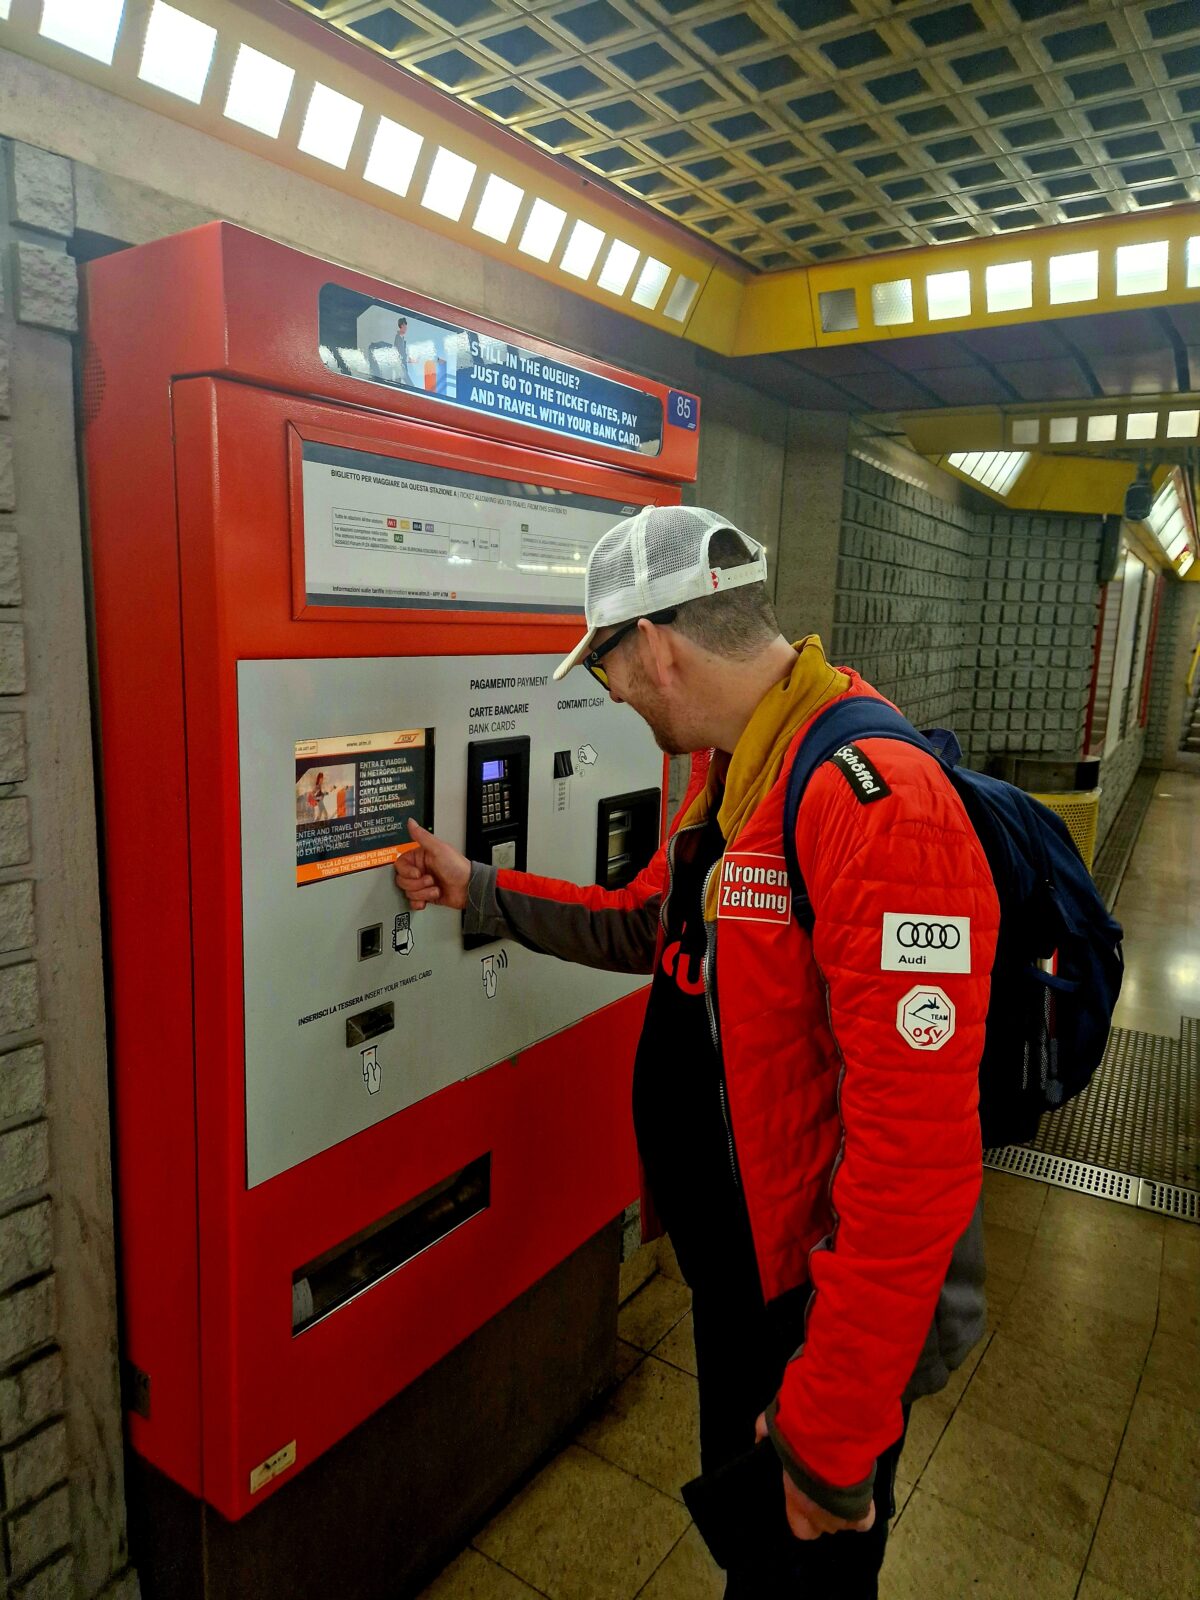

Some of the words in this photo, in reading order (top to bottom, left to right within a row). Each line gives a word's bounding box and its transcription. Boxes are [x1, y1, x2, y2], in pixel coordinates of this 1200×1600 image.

[471, 341, 503, 365] STILL
[506, 352, 518, 370] IN
[520, 358, 540, 377] THE
[542, 365, 580, 390] QUEUE?
[470, 365, 499, 386] JUST
[502, 374, 516, 391] GO
[519, 379, 532, 396] TO
[534, 383, 554, 403] THE
[556, 391, 589, 413] TICKET
[591, 404, 620, 424] GATES,
[622, 412, 637, 428] PAY
[677, 396, 691, 419] 85
[470, 387, 495, 407] AND
[497, 394, 537, 419] TRAVEL
[540, 406, 565, 427] WITH
[567, 414, 591, 433] YOUR
[593, 425, 617, 441] BANK
[618, 432, 642, 448] CARD.
[331, 469, 361, 481] BIGLIETTO
[361, 474, 372, 483] PER
[373, 477, 400, 488] VIAGGIARE
[409, 483, 429, 492] QUESTA
[429, 486, 453, 497] STAZIONE
[387, 519, 396, 528] M1
[470, 678, 516, 690] PAGAMENTO
[517, 676, 548, 688] PAYMENT
[469, 706, 493, 718] CARTE
[494, 703, 529, 716] BANCARIE
[557, 699, 587, 710] CONTANTI
[588, 698, 604, 708] CASH
[468, 722, 489, 735] BANK
[491, 720, 516, 732] CARDS
[359, 760, 379, 769] ENTRA
[380, 759, 384, 767] E
[385, 757, 407, 766] VIAGGIA
[360, 769, 366, 778] IN
[367, 765, 413, 777] METROPOLITANA
[359, 778, 371, 787] CON
[372, 777, 380, 786] LA
[380, 776, 393, 785] TUA
[359, 787, 378, 796] CARTA
[379, 783, 407, 794] BANCARIA
[359, 794, 400, 806] CONTACTLESS,
[359, 804, 378, 815] SENZA
[379, 799, 415, 811] COMMISSIONI
[296, 829, 316, 840] ENTER
[317, 827, 330, 836] AND
[331, 823, 353, 834] TRAVEL
[354, 821, 362, 829] ON
[363, 819, 375, 828] THE
[375, 816, 394, 826] METRO
[329, 827, 369, 843] CONTACTLESS
[370, 824, 386, 835] BANK
[305, 844, 324, 856] EXTRA
[325, 840, 350, 853] CHARGE
[317, 860, 334, 870] TOCCA
[334, 859, 342, 867] LO
[343, 855, 366, 865] SCHERMO
[366, 851, 376, 861] PER
[321, 866, 340, 877] TOUCH
[340, 863, 350, 873] THE
[350, 860, 370, 871] SCREEN
[371, 859, 378, 867] TO
[378, 855, 393, 865] START
[723, 862, 789, 887] Kronen
[722, 886, 788, 914] Zeitung
[898, 954, 927, 965] Audi
[298, 1008, 329, 1026] INSERISCI
[329, 1005, 337, 1014] LA
[338, 995, 363, 1011] TESSERA
[364, 988, 383, 1001] INSERT
[384, 982, 399, 994] YOUR
[399, 975, 418, 989] TRAVEL
[418, 969, 433, 981] CARD
